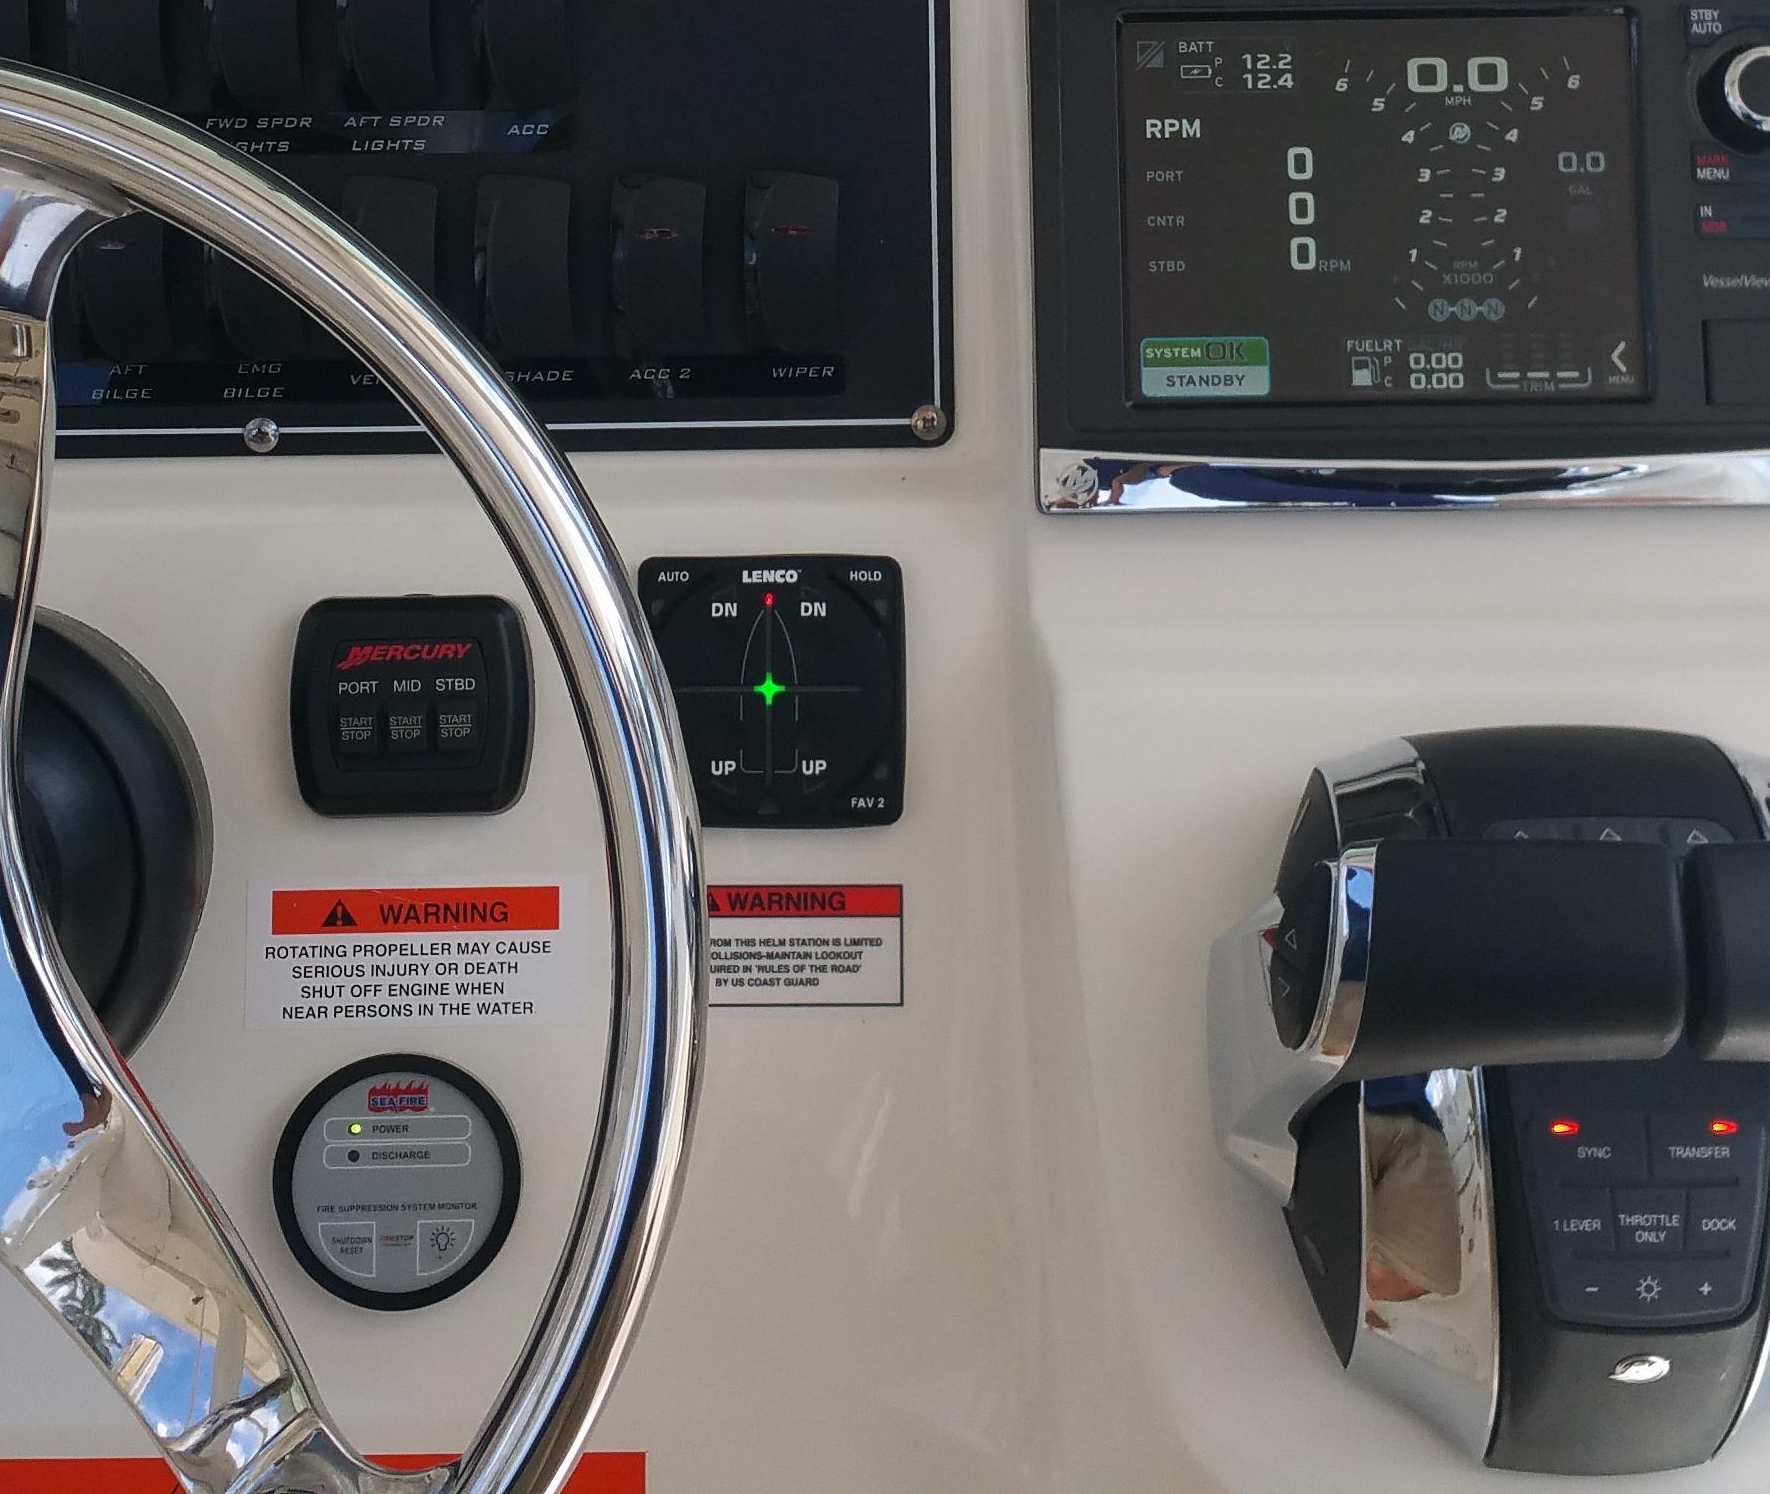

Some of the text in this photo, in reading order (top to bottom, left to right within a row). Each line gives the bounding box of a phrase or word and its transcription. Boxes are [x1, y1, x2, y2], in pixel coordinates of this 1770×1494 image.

[1690, 9, 1719, 20] STBY
[1691, 22, 1722, 35] AUTO
[1178, 41, 1214, 53] BATT
[1242, 54, 1292, 69] 12.2
[1242, 73, 1294, 89] 12.4
[1407, 57, 1508, 93] 0.0
[1445, 96, 1472, 106] MPH
[205, 116, 313, 129] FWD SPDR
[344, 115, 445, 127] AFT SPDR
[507, 124, 551, 136] ACC
[1145, 119, 1201, 138] RPM
[352, 140, 427, 152] LIGHTS
[1146, 147, 1313, 182] PORT 0
[1557, 151, 1605, 173] 0.0
[1696, 166, 1730, 180] MENU
[1147, 192, 1315, 227] CNTR 0
[1700, 205, 1713, 218] IN
[1148, 236, 1351, 272] STBD 0 RPM
[1443, 273, 1493, 285] X1000
[1346, 339, 1402, 351] FUELRT
[1145, 342, 1246, 362] SYSTEM OK
[1408, 352, 1463, 368] 0.00
[109, 364, 148, 375] AFT
[238, 363, 282, 374] EMG
[629, 368, 692, 381] ACC 2
[771, 365, 835, 378] WIPER
[1166, 373, 1246, 387] STANDBY
[1409, 373, 1465, 389] 0.00
[91, 388, 153, 400] BILGE
[223, 387, 285, 399] BILGE
[657, 571, 690, 583] AUTO
[742, 569, 799, 584] LENCO
[849, 570, 882, 582] HOLD
[711, 602, 738, 618] DN
[800, 602, 827, 617] DN
[336, 642, 473, 671] MERCURY
[338, 677, 476, 695] PORT MID STBD
[340, 716, 373, 727] START
[389, 714, 423, 726] START
[439, 714, 473, 724] START
[342, 730, 371, 741] STOP
[391, 728, 421, 740] STOP
[440, 727, 471, 738] STOP
[711, 760, 737, 776] UP
[801, 760, 827, 775] UP
[851, 797, 885, 808] FAV 2
[727, 892, 846, 912] WARNING
[379, 902, 509, 925] WARNING
[735, 937, 883, 947] THIS HELM STATION IS LIMITED
[265, 941, 551, 960] ROTATING PROPELLER MAY CAUSE
[815, 951, 864, 960] LOOKOUT
[292, 962, 518, 979] SERIOUS INJURY OR DEATH
[742, 964, 828, 974] IN OF THE
[715, 978, 819, 987] BY US COAST GUARD
[301, 982, 505, 999] SHUT OFF ENGINE WHEN
[282, 1005, 328, 1020] NEAR
[333, 1004, 413, 1019] PERSONS
[418, 1003, 434, 1017] IN
[439, 1003, 471, 1016] THE
[372, 1125, 409, 1134] POWER
[372, 1150, 430, 1161] DISCHARGE
[1578, 1147, 1612, 1159] SYNC
[1669, 1146, 1730, 1158] TRANSFER
[316, 1202, 477, 1213] FIRE SUPPRESSION SYSTEM MONITOR
[1564, 1219, 1601, 1231] LEVER
[1618, 1214, 1680, 1226] THROTTLE
[1702, 1218, 1736, 1231] DOCK
[1635, 1231, 1666, 1243] ONLY
